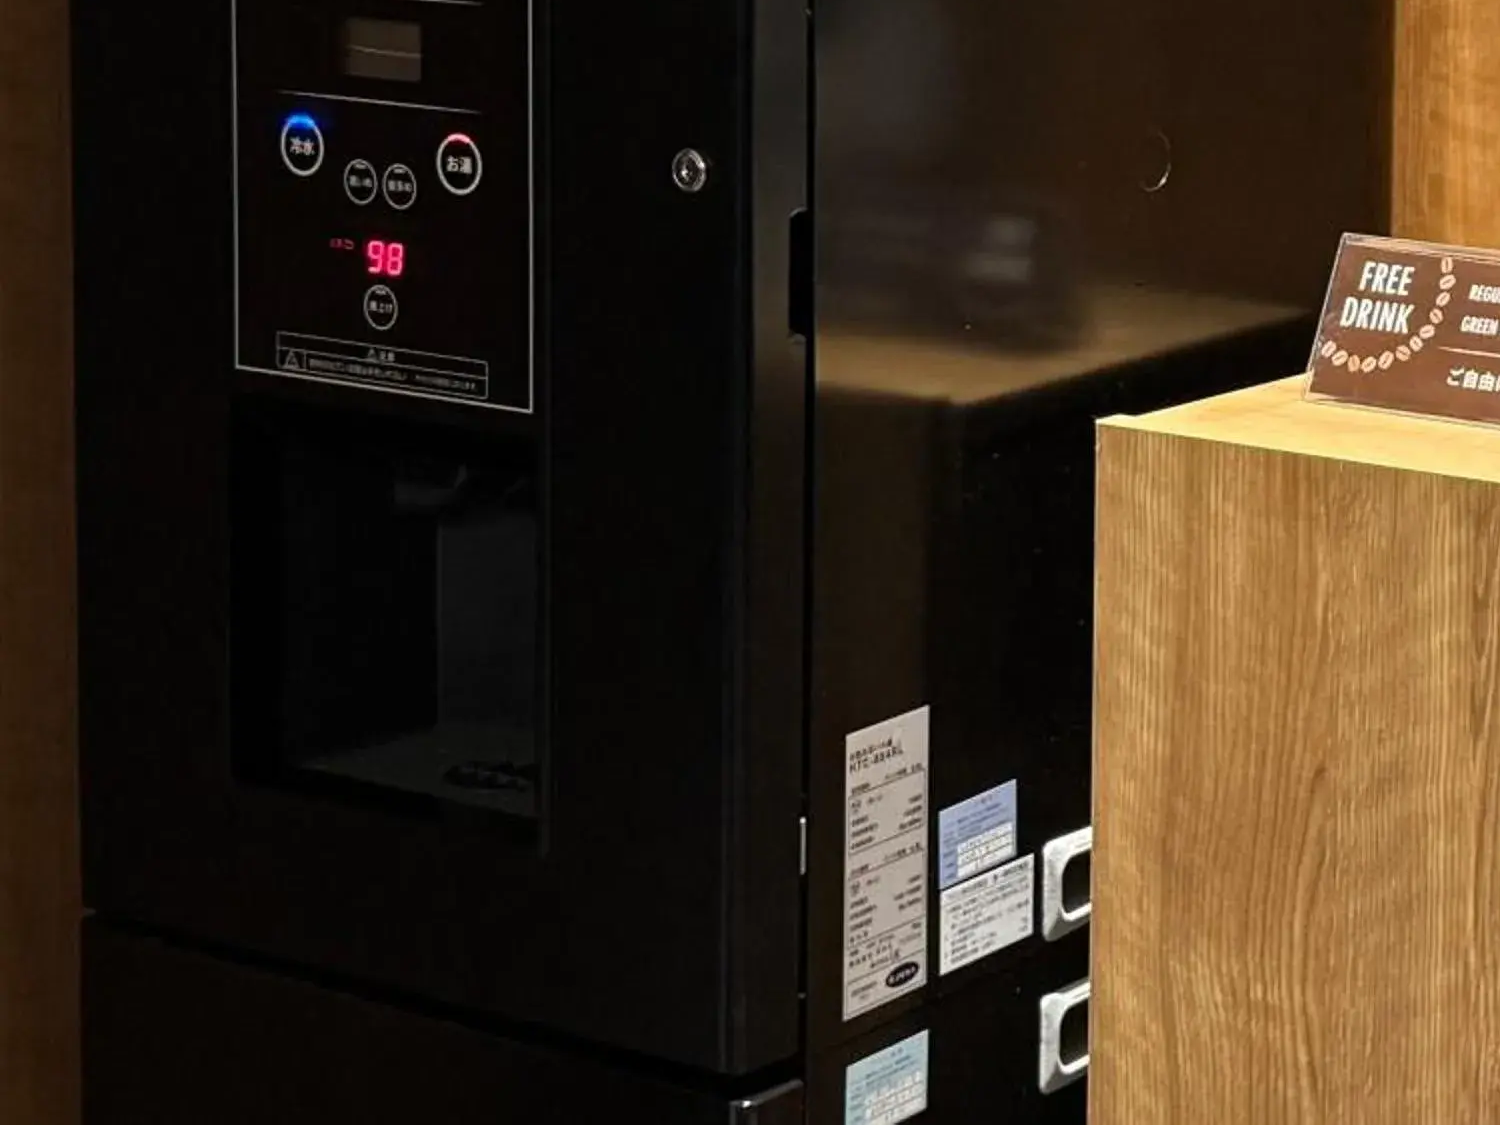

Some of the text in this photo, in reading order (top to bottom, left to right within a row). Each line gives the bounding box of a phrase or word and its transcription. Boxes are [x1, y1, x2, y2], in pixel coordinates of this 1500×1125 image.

[367, 240, 403, 276] 98
[1358, 261, 1415, 297] FREE
[1339, 297, 1415, 334] DRINK
[1460, 315, 1500, 335] GREEN
